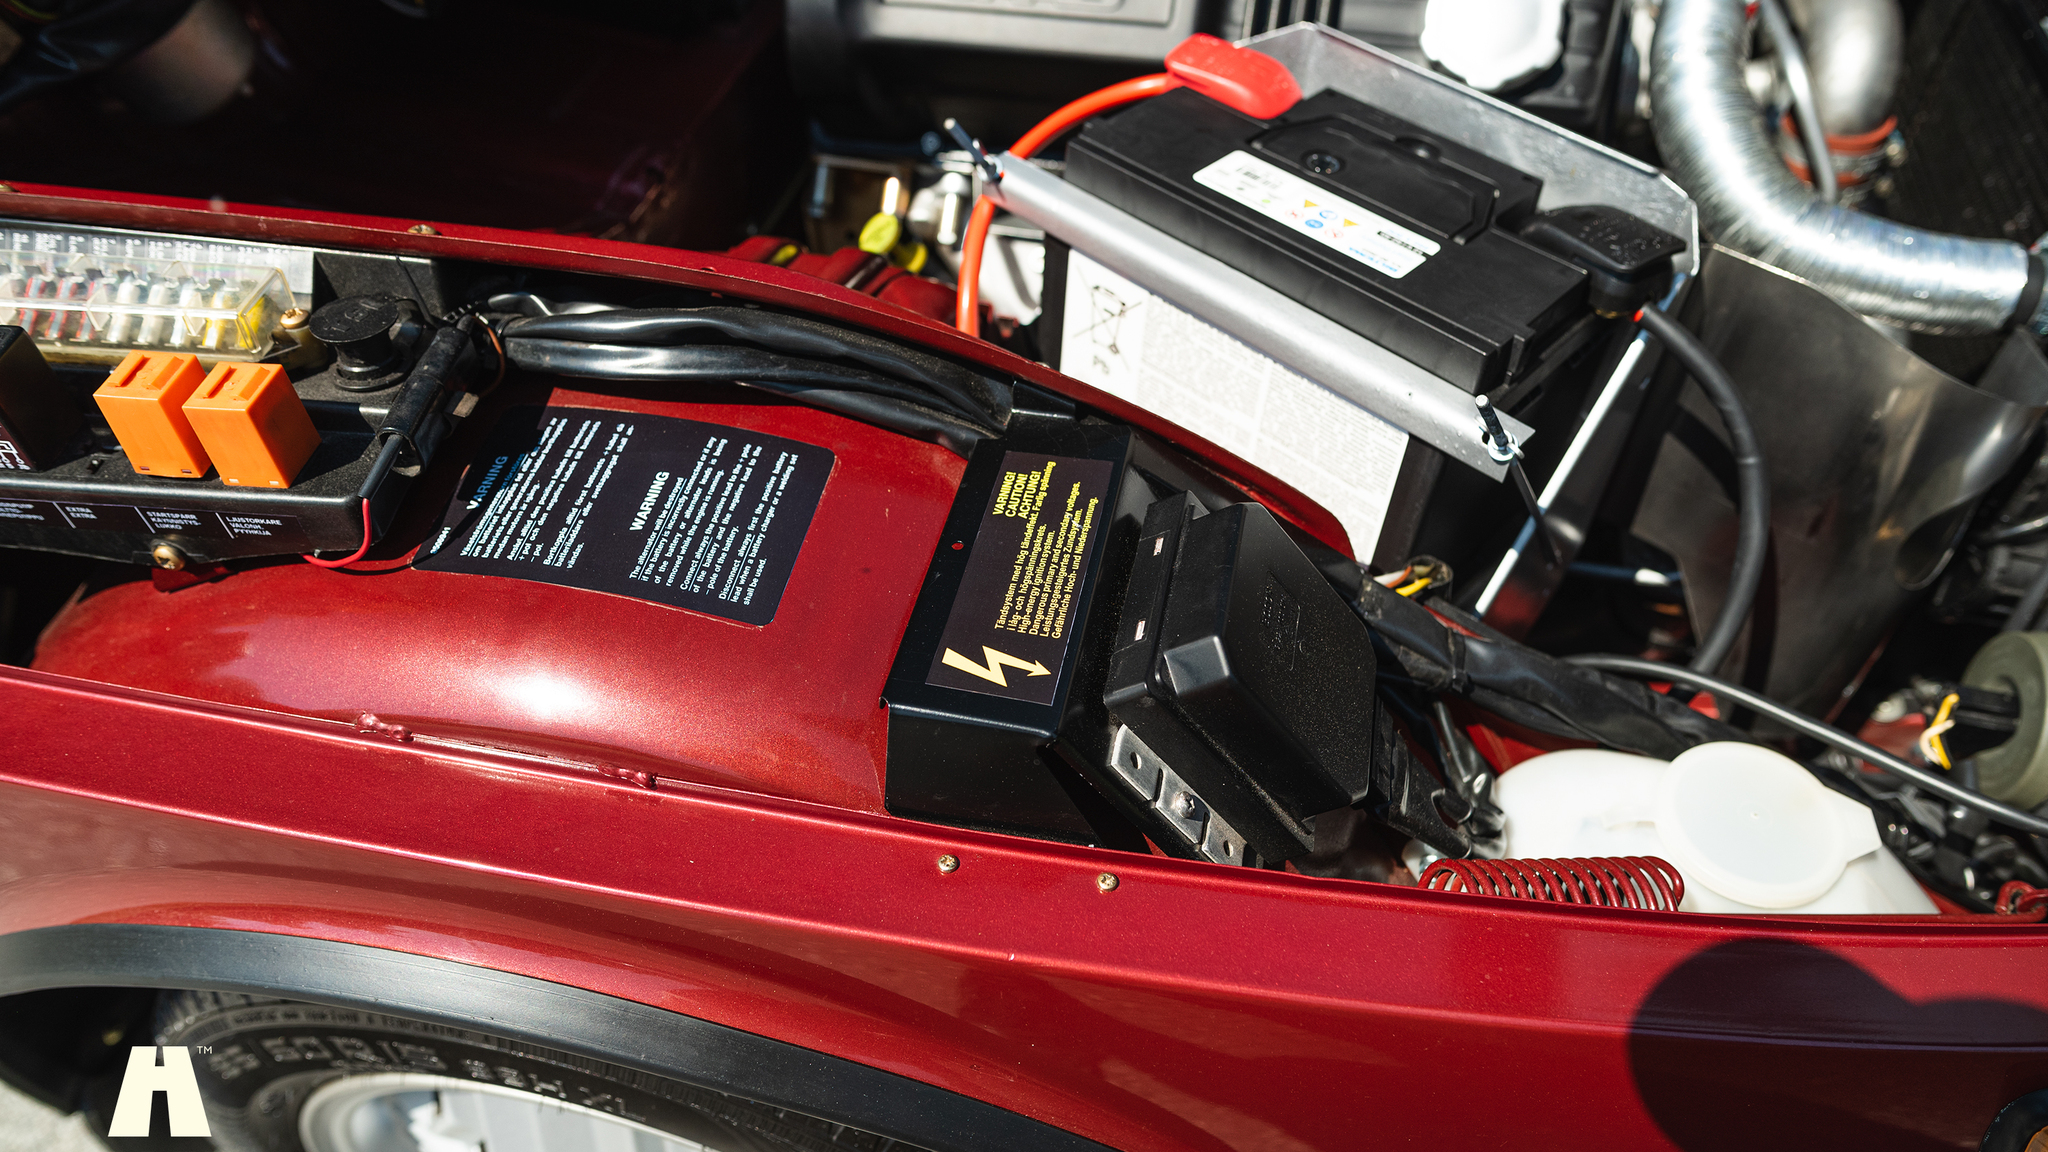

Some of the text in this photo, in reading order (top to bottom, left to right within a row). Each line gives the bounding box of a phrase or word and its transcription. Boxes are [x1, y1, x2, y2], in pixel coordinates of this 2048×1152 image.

[700, 453, 708, 462] or
[741, 443, 752, 459] pole
[466, 456, 508, 509] VARNING
[683, 460, 704, 495] connected
[728, 474, 738, 482] to
[732, 463, 743, 475] the
[629, 471, 670, 531] WARNING
[721, 481, 734, 497] lead
[992, 471, 1017, 515] VARNING!
[1004, 473, 1029, 517] CAUTION!
[1017, 470, 1042, 519] ACHTUNG!
[1031, 491, 1048, 511] Farlig
[654, 575, 662, 584] of
[658, 560, 669, 573] the
[664, 532, 683, 558] battery
[679, 521, 687, 530] or
[684, 486, 703, 519] alternator
[698, 467, 713, 485] leads
[665, 494, 689, 530] incorrectly
[693, 445, 763, 593] of the battery and the negative lead to the
[711, 496, 727, 524] positive
[718, 451, 789, 600] Disconnect always first the positive battery
[628, 477, 684, 579] The alternator will be destroyed
[665, 554, 684, 587] removed
[679, 536, 693, 555] while
[687, 524, 698, 536] the
[693, 501, 709, 525] engine
[707, 469, 725, 496] running.
[704, 523, 715, 535] the
[721, 525, 740, 552] battery.
[730, 586, 743, 603] lead
[738, 565, 751, 585] when
[748, 532, 766, 558] battery
[760, 505, 776, 532] charger
[772, 496, 780, 505] or
[789, 454, 799, 465] set
[1020, 511, 1039, 549] tändeffekt.
[649, 537, 668, 563] battery
[694, 535, 713, 561] always
[716, 552, 728, 564] the
[1015, 549, 1029, 565] hög
[1017, 523, 1047, 594] högspänningskrets.
[1028, 481, 1081, 636] Dangerous primary and secondary voltages.
[644, 563, 655, 575] the
[679, 559, 699, 590] Connect
[707, 572, 719, 590] pole
[714, 563, 722, 573] of
[743, 558, 767, 606] shall be used.
[1011, 564, 1023, 582] med
[1051, 497, 1099, 639] Gefährliche Hoch- und Niederspannung.
[994, 582, 1017, 630] Tändsystem
[1015, 595, 1026, 611] och
[1017, 586, 1041, 634] High-energy
[1039, 553, 1074, 637] Leistungsgesteigertes
[1007, 611, 1023, 629] låg-
